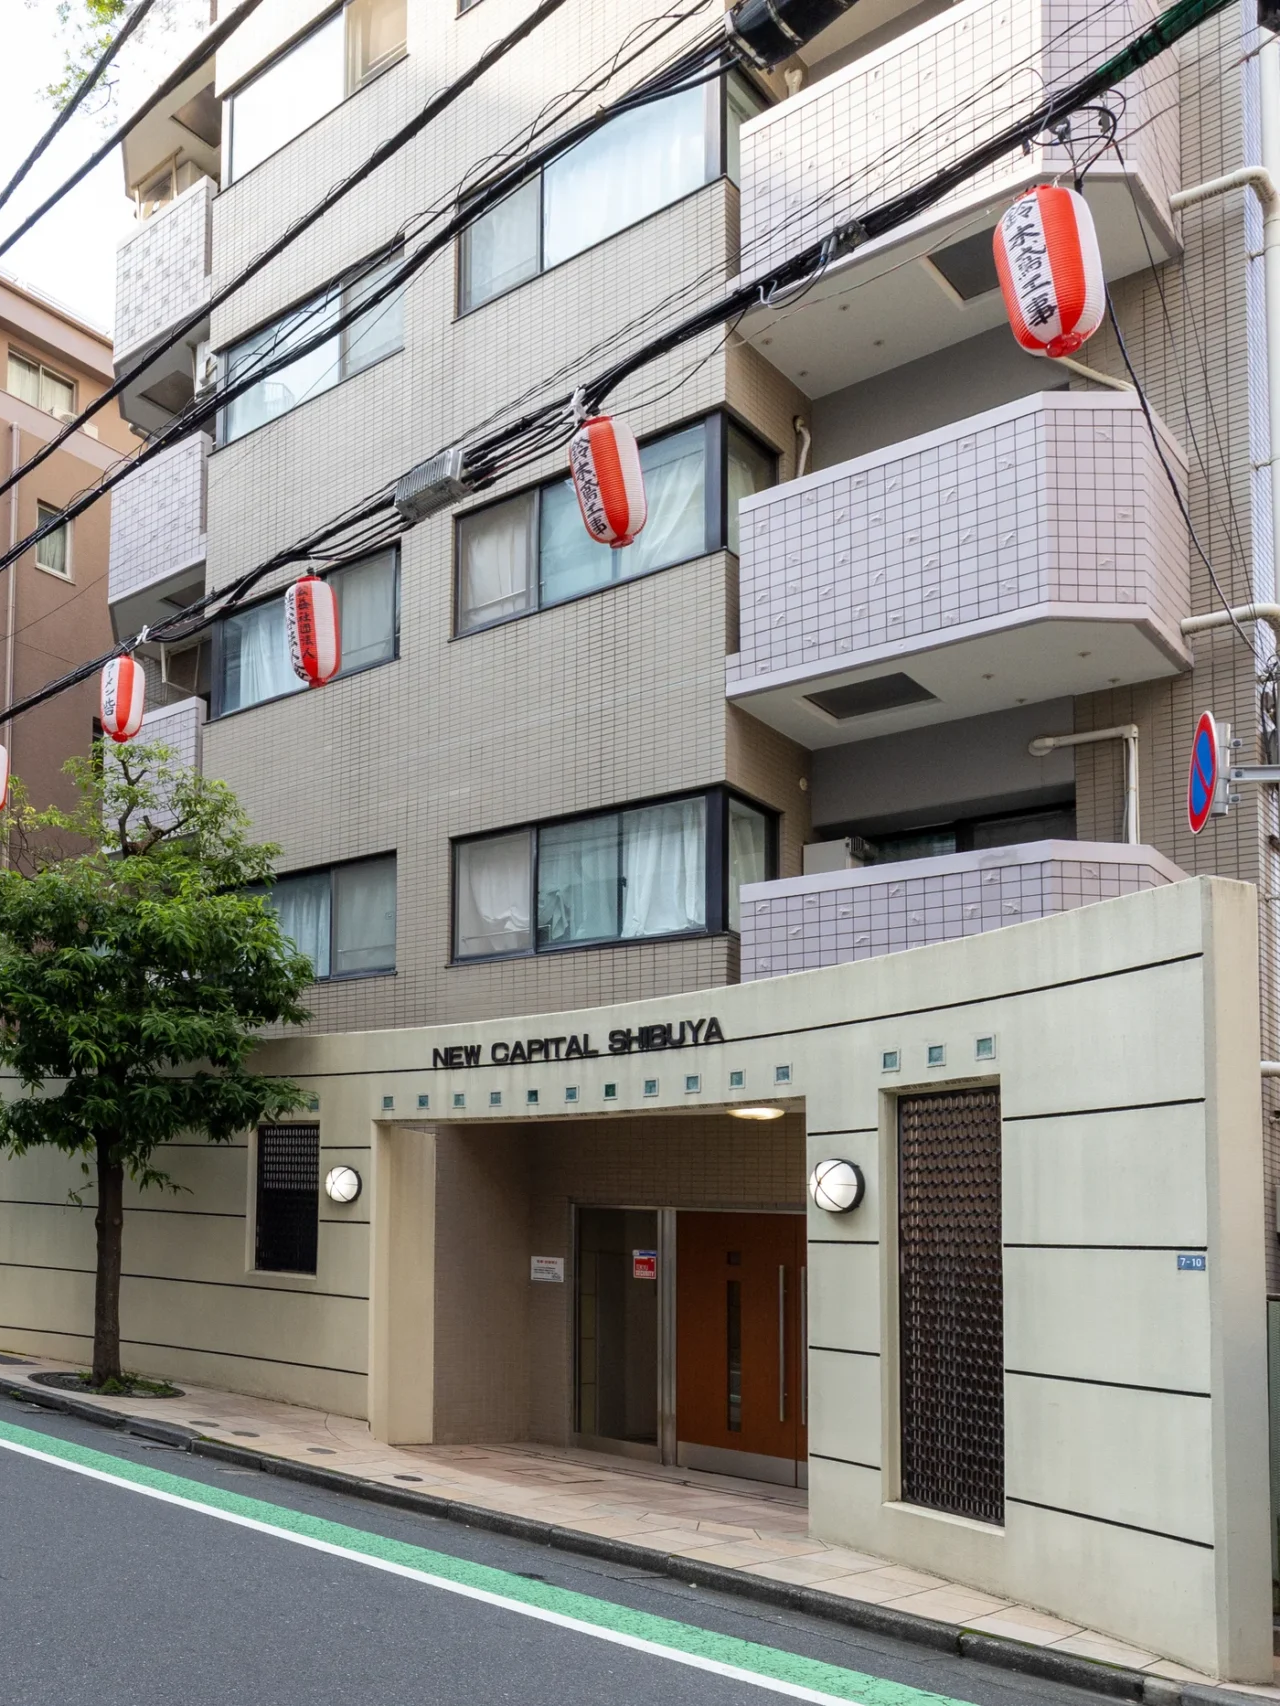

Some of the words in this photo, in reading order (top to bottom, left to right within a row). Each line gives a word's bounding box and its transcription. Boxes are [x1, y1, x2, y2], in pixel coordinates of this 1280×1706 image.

[432, 1044, 482, 1068] NEW
[491, 1033, 599, 1064] CAPITAL
[608, 1016, 725, 1052] SHIBUYA
[1180, 1257, 1202, 1267] 7-10
